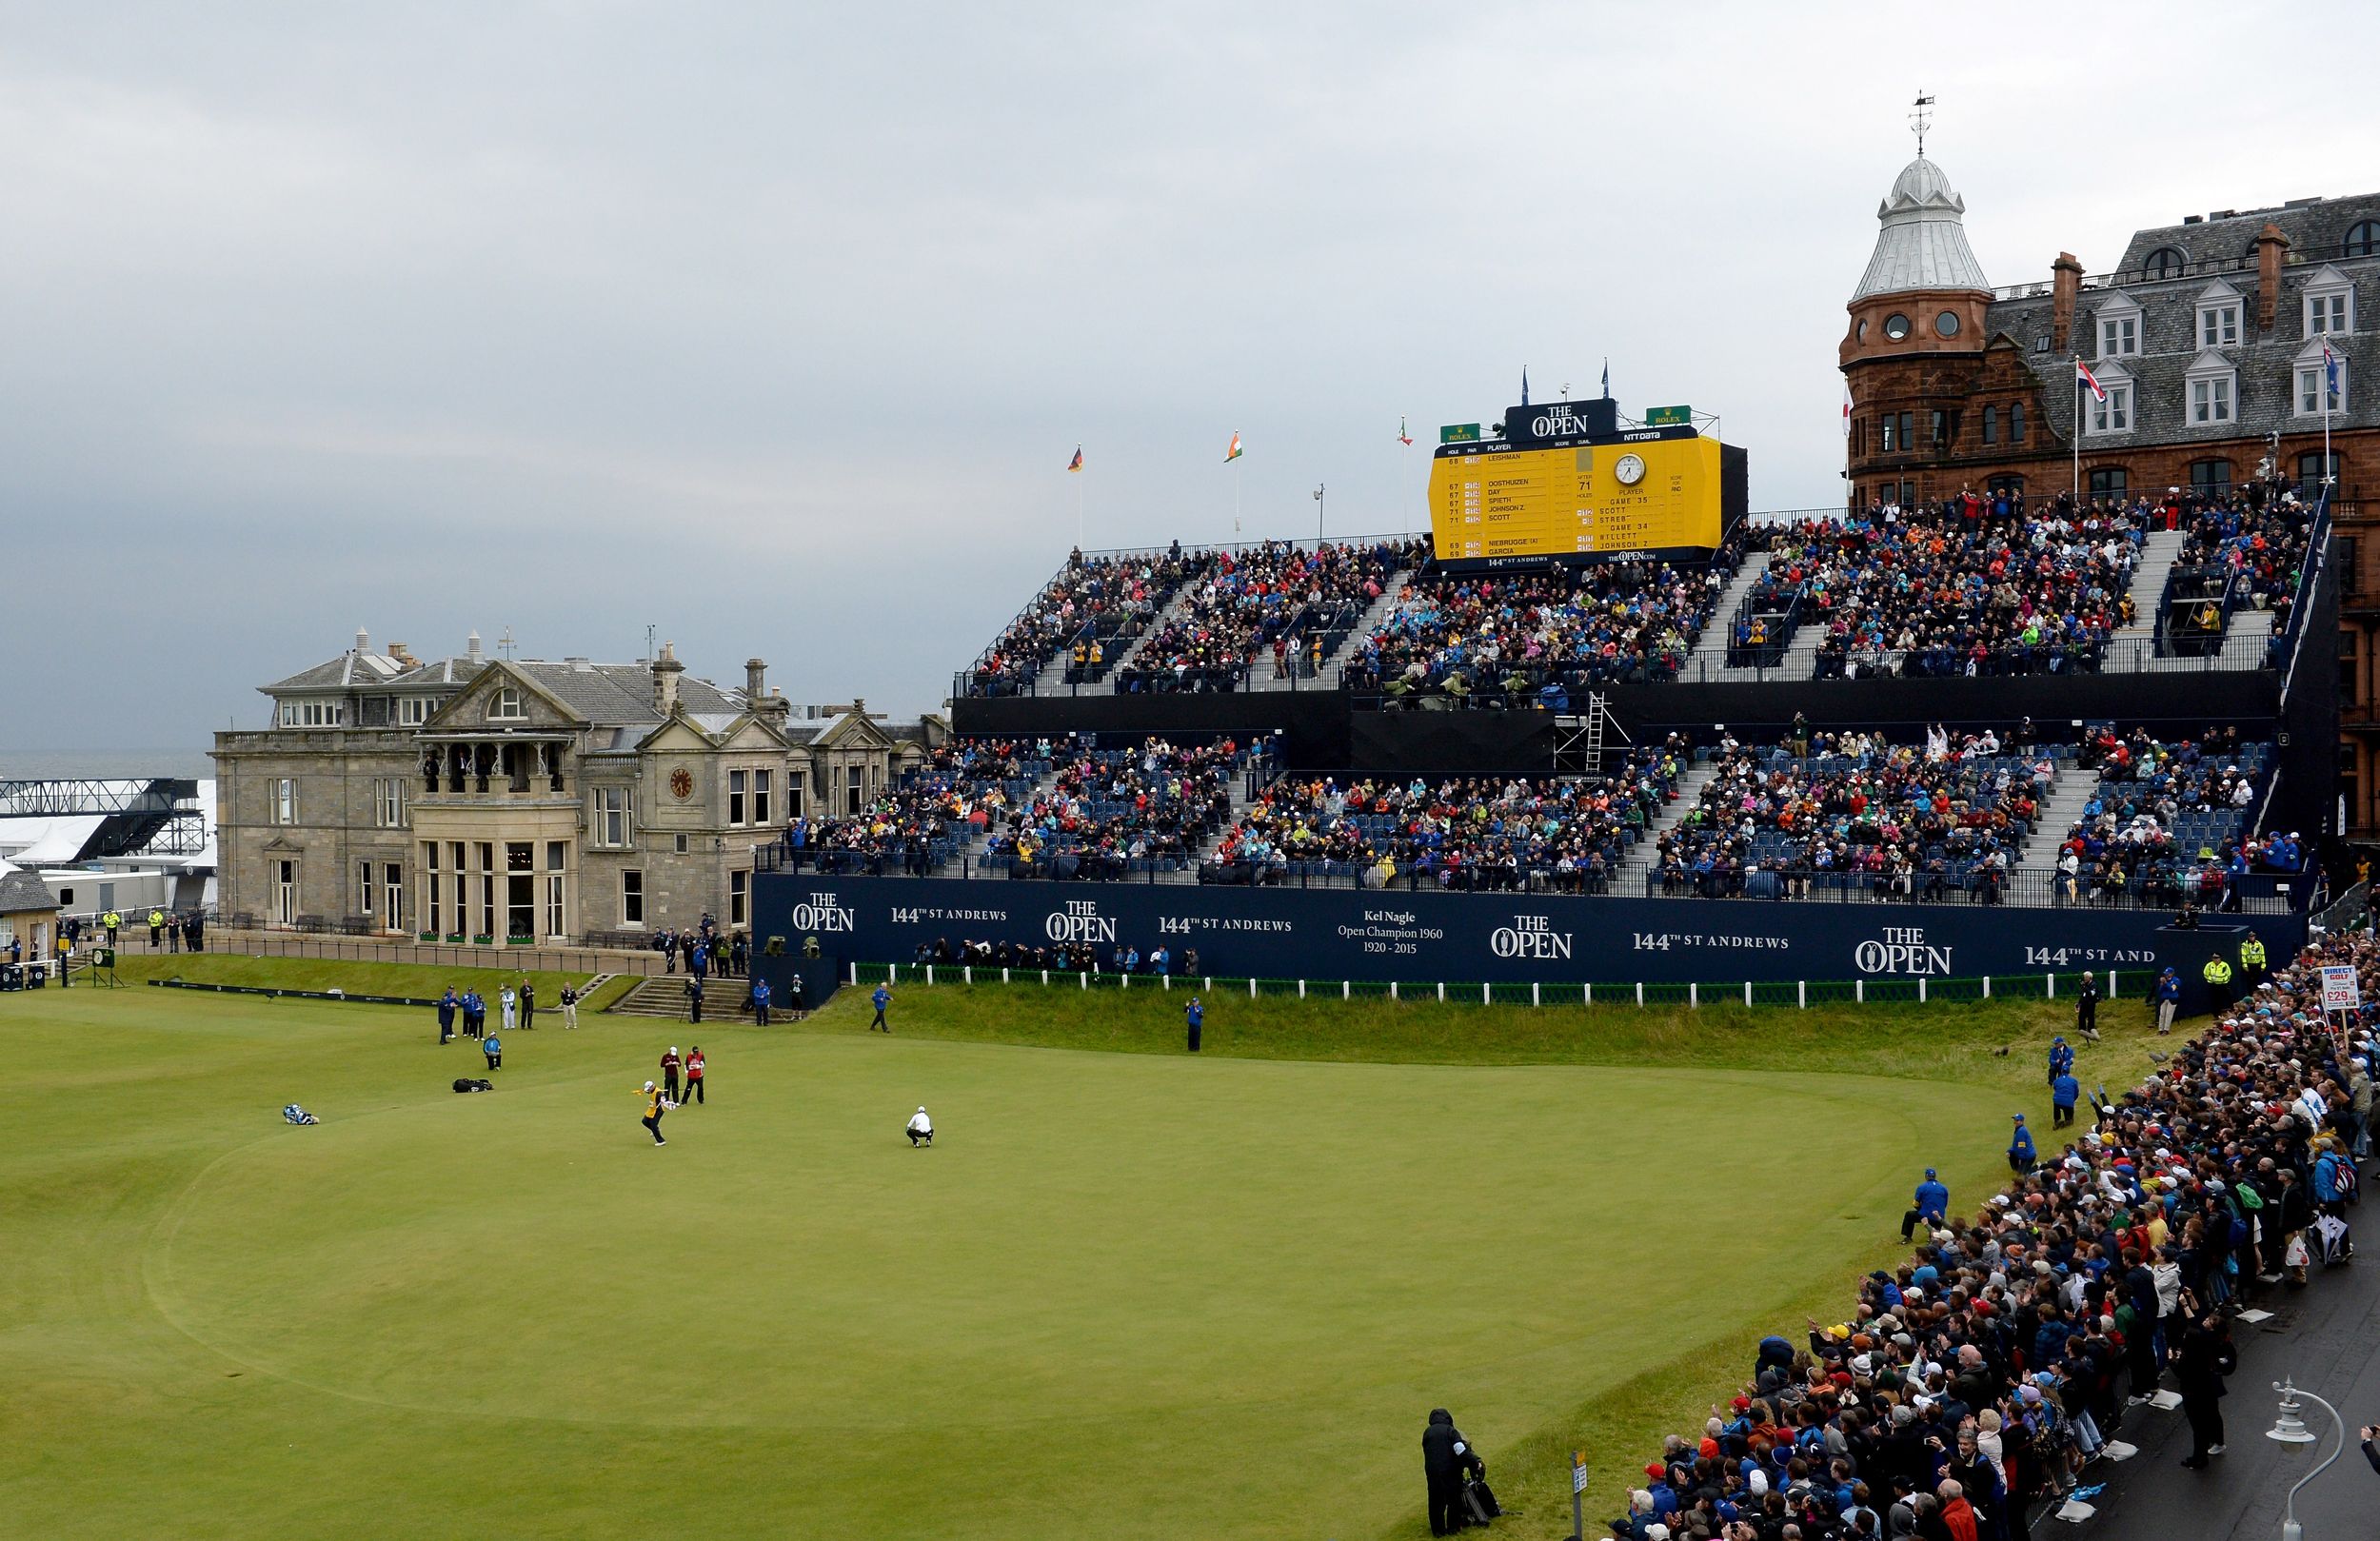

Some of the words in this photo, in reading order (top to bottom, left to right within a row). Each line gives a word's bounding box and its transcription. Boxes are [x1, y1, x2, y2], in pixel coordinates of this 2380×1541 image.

[1548, 405, 1572, 417] THE
[1532, 415, 1588, 437] OPEN
[1579, 482, 1590, 490] 71
[810, 893, 837, 906] THE
[891, 908, 926, 923] 144TH
[929, 909, 943, 919] ST
[946, 910, 1006, 921] ANDREWS
[1066, 900, 1097, 916] THE
[793, 904, 855, 932] OPEN
[1160, 917, 1200, 933] 144TH
[1202, 919, 1219, 929] ST
[1222, 919, 1292, 932] ANDREWS
[1364, 911, 1382, 921] Kel
[1384, 912, 1415, 925] Nagle
[1514, 915, 1549, 931] THE
[1046, 913, 1117, 942] OPEN
[1339, 925, 1364, 938] Open
[1366, 926, 1418, 940] Champion
[1420, 929, 1443, 939] 1960
[1883, 927, 1924, 944] THE
[1364, 942, 1386, 953] 1920
[1395, 943, 1417, 954] 2015
[1491, 927, 1573, 959] OPEN
[1634, 933, 1681, 950] 144TH
[1684, 935, 1702, 946] ST
[1707, 936, 1789, 949] ANDREWS
[1855, 940, 1953, 975] OPEN
[2024, 947, 2081, 965] 144TH
[2086, 949, 2108, 959] ST
[2113, 950, 2155, 962] AND
